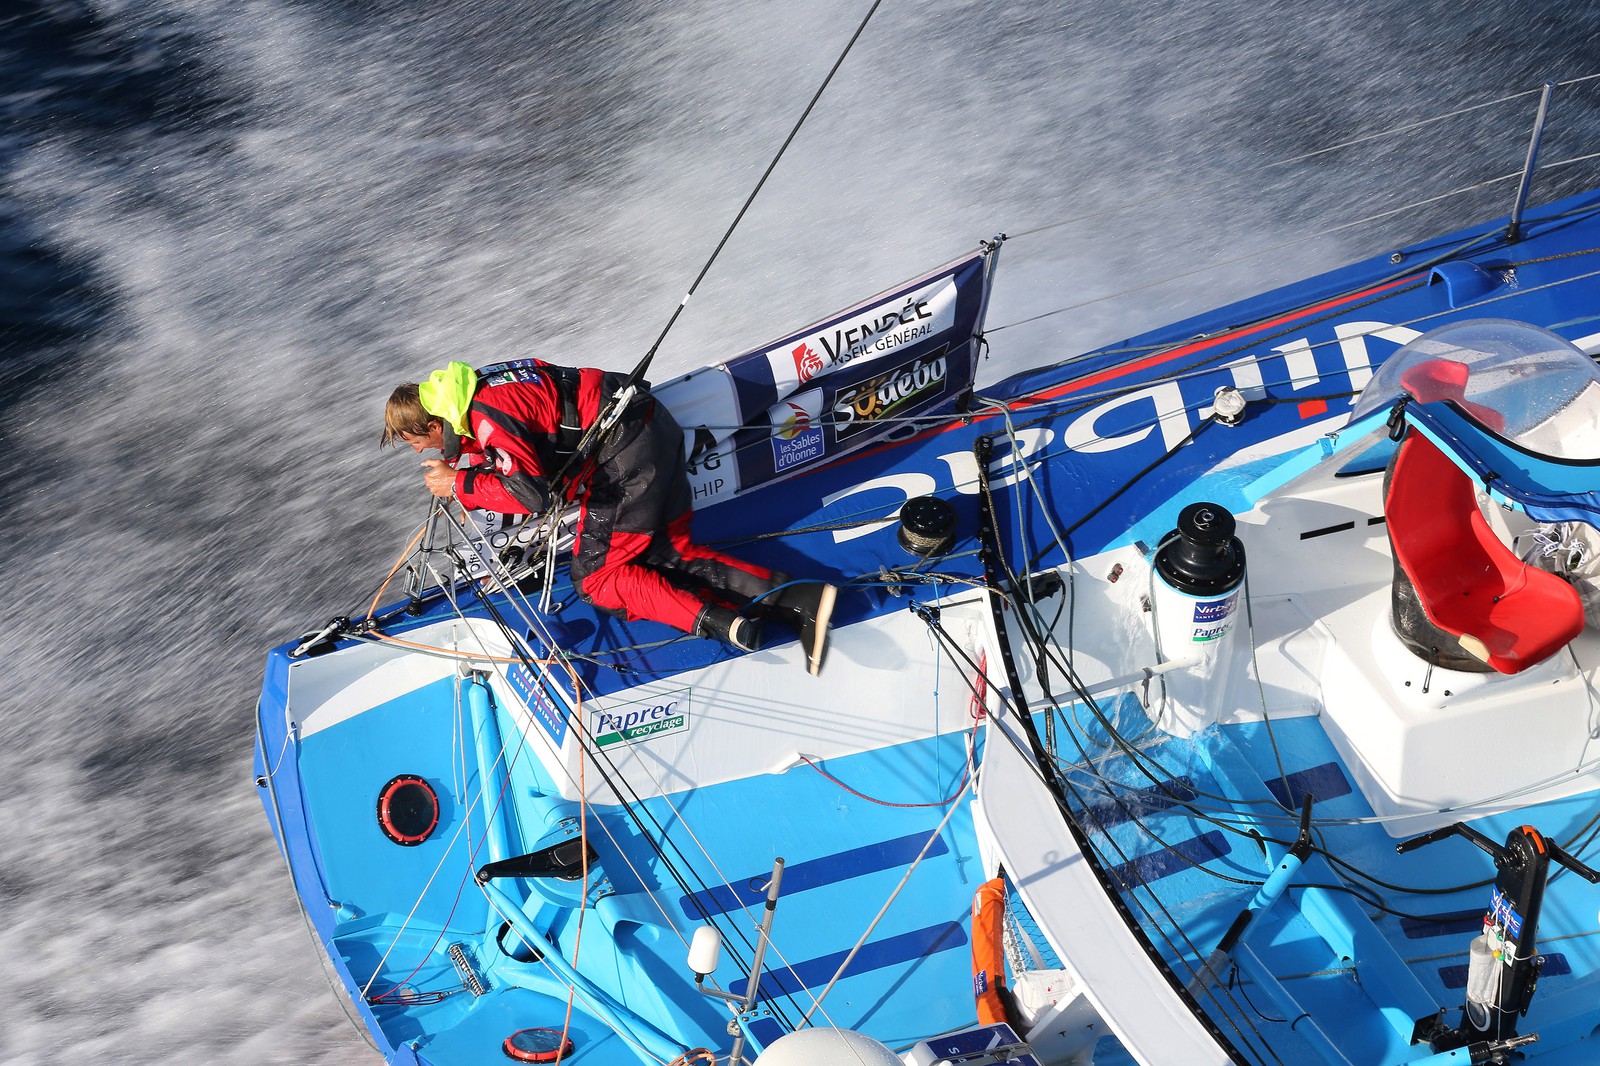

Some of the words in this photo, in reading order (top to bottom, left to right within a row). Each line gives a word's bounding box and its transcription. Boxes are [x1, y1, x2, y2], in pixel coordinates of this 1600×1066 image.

[874, 323, 933, 351] GÉNÉRAL
[779, 444, 791, 454] les
[791, 434, 820, 451] Sables
[778, 446, 817, 467] d'Olonne
[597, 701, 678, 735] Paprec
[630, 716, 682, 737] recyclage
